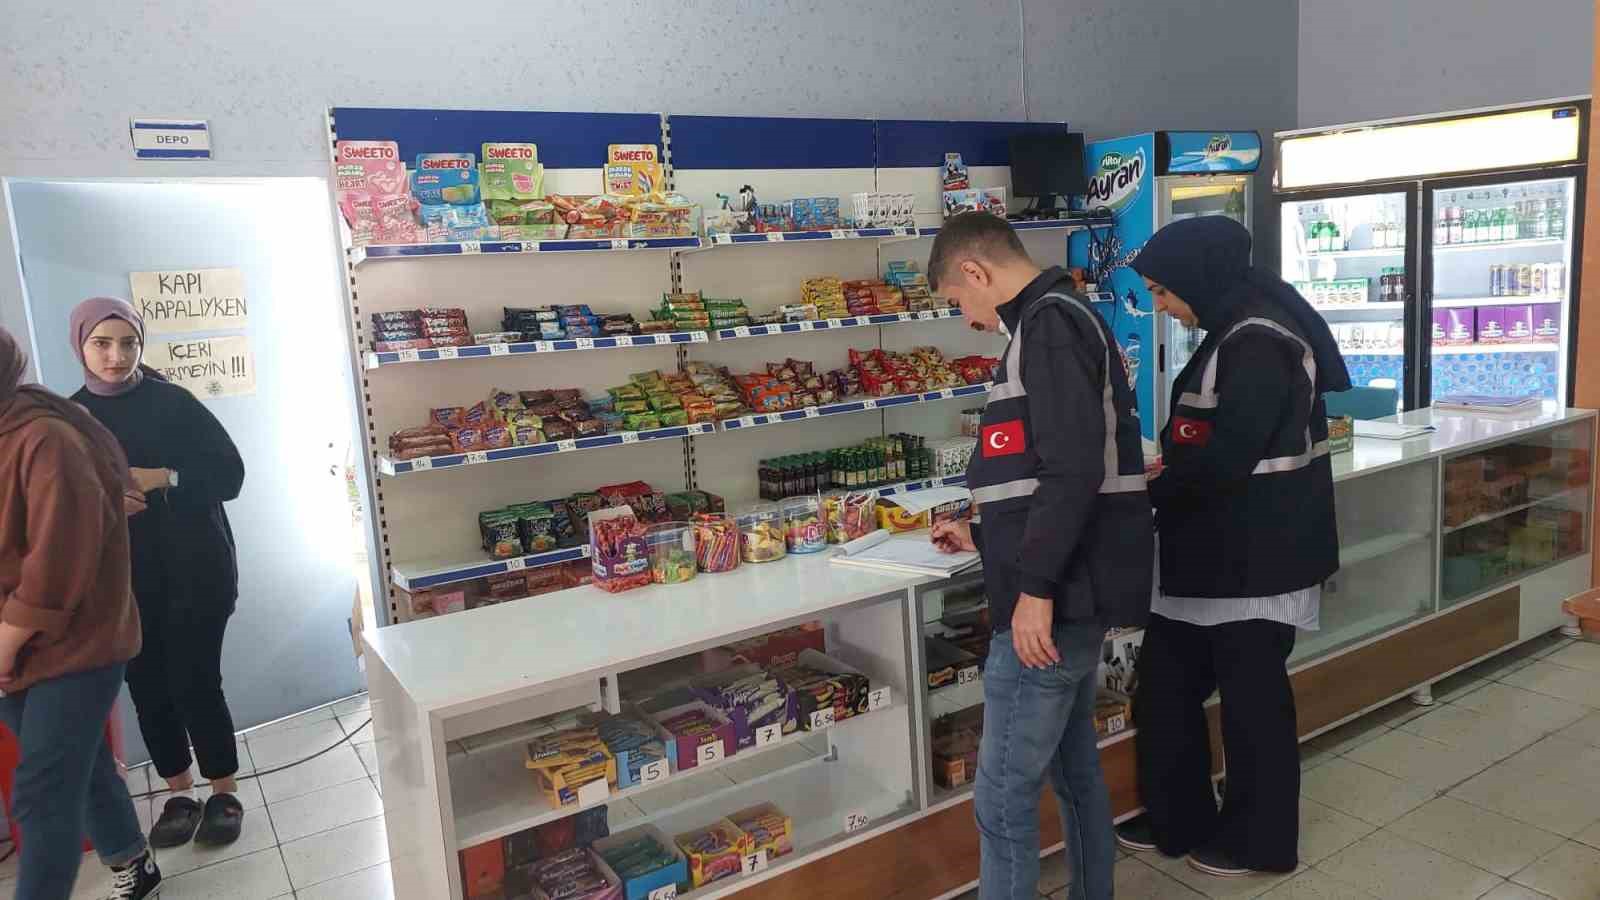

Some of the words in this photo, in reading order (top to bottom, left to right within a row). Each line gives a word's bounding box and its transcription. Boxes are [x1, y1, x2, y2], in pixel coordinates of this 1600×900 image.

[156, 135, 189, 145] DEPO
[344, 147, 394, 158] SWEETO
[488, 147, 532, 158] SWEETO
[613, 150, 654, 161] SWEETO
[423, 159, 470, 169] SWEETO
[1087, 159, 1140, 205] Ayran
[158, 273, 202, 295] KAPI
[870, 691, 883, 706] 7
[763, 729, 775, 742] 7
[704, 746, 716, 761] 5
[646, 765, 661, 781] 5
[747, 854, 759, 872] 7
